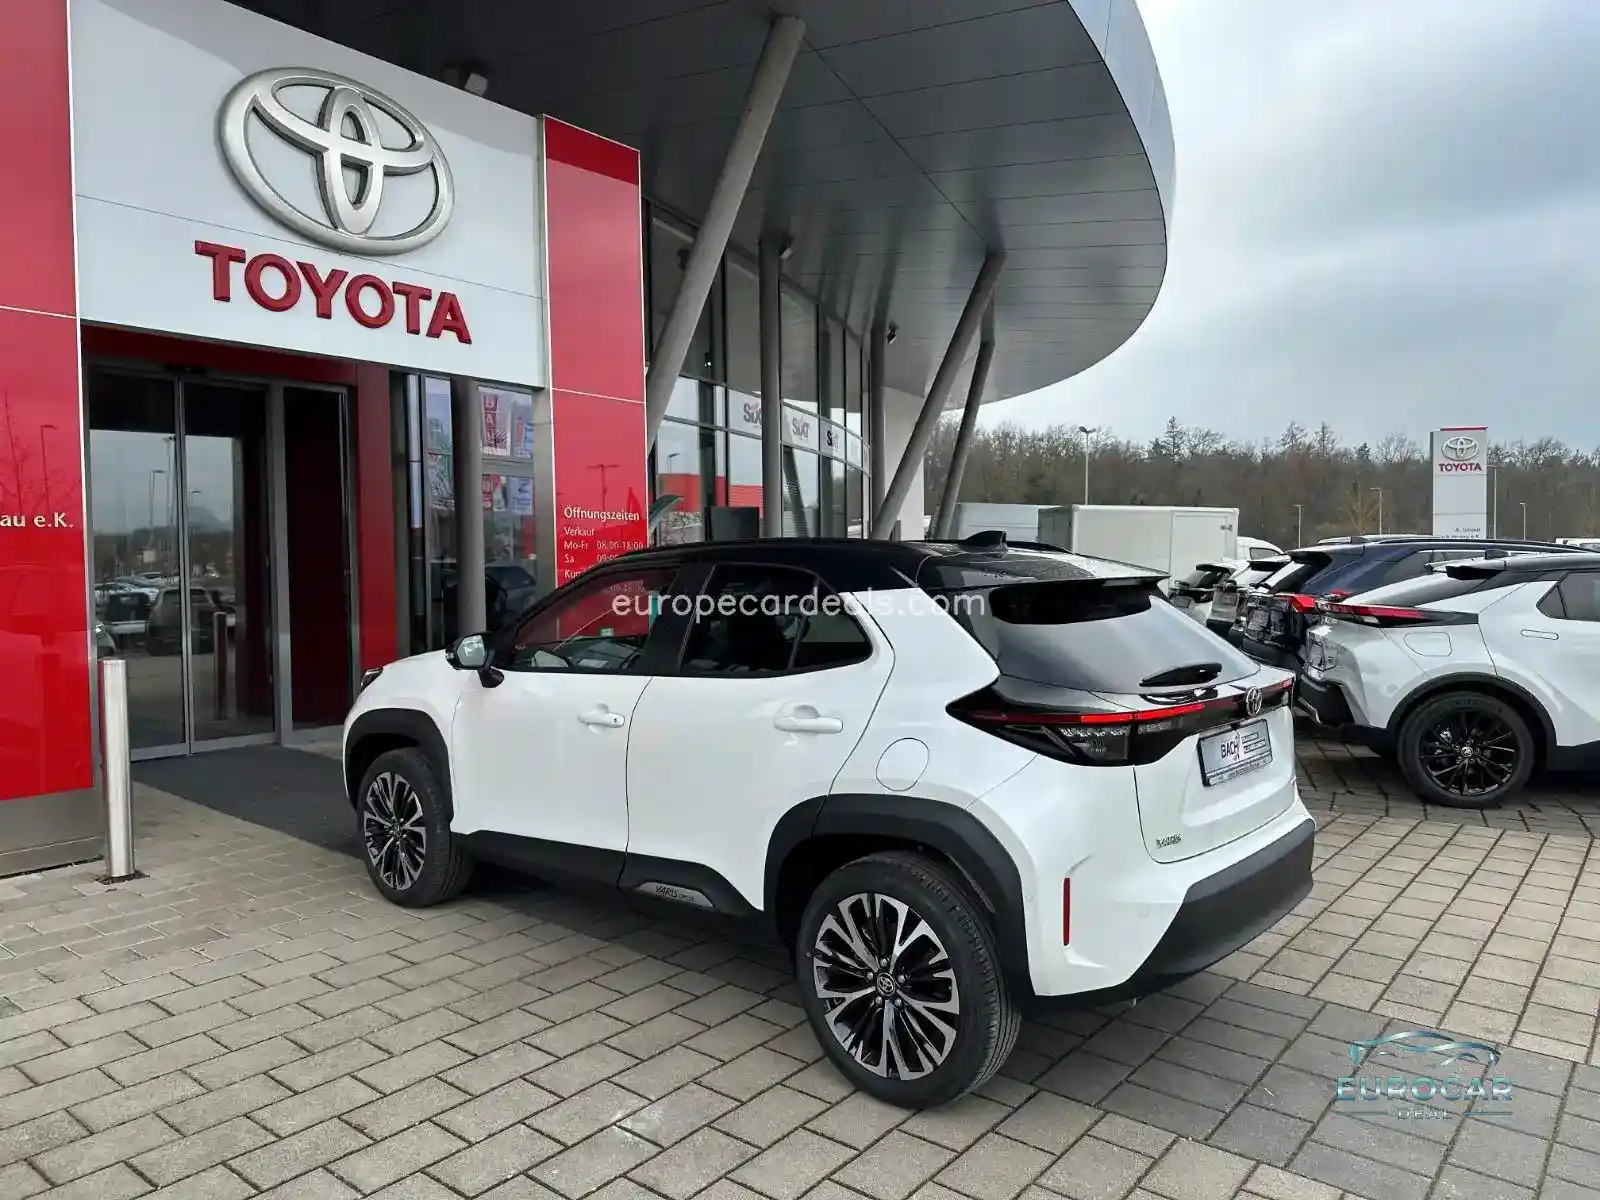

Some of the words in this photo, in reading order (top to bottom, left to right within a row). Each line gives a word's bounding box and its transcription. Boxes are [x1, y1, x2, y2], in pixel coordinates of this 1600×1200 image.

[194, 239, 472, 344] TOYOTA
[1438, 463, 1482, 472] TOYOTA
[33, 511, 74, 528] e.K.
[564, 504, 640, 523] Öffnungszeiten
[564, 526, 595, 537] Verkauf
[564, 540, 589, 550] Mo-Fr
[564, 554, 575, 563] Sa
[1220, 740, 1240, 759] BACH
